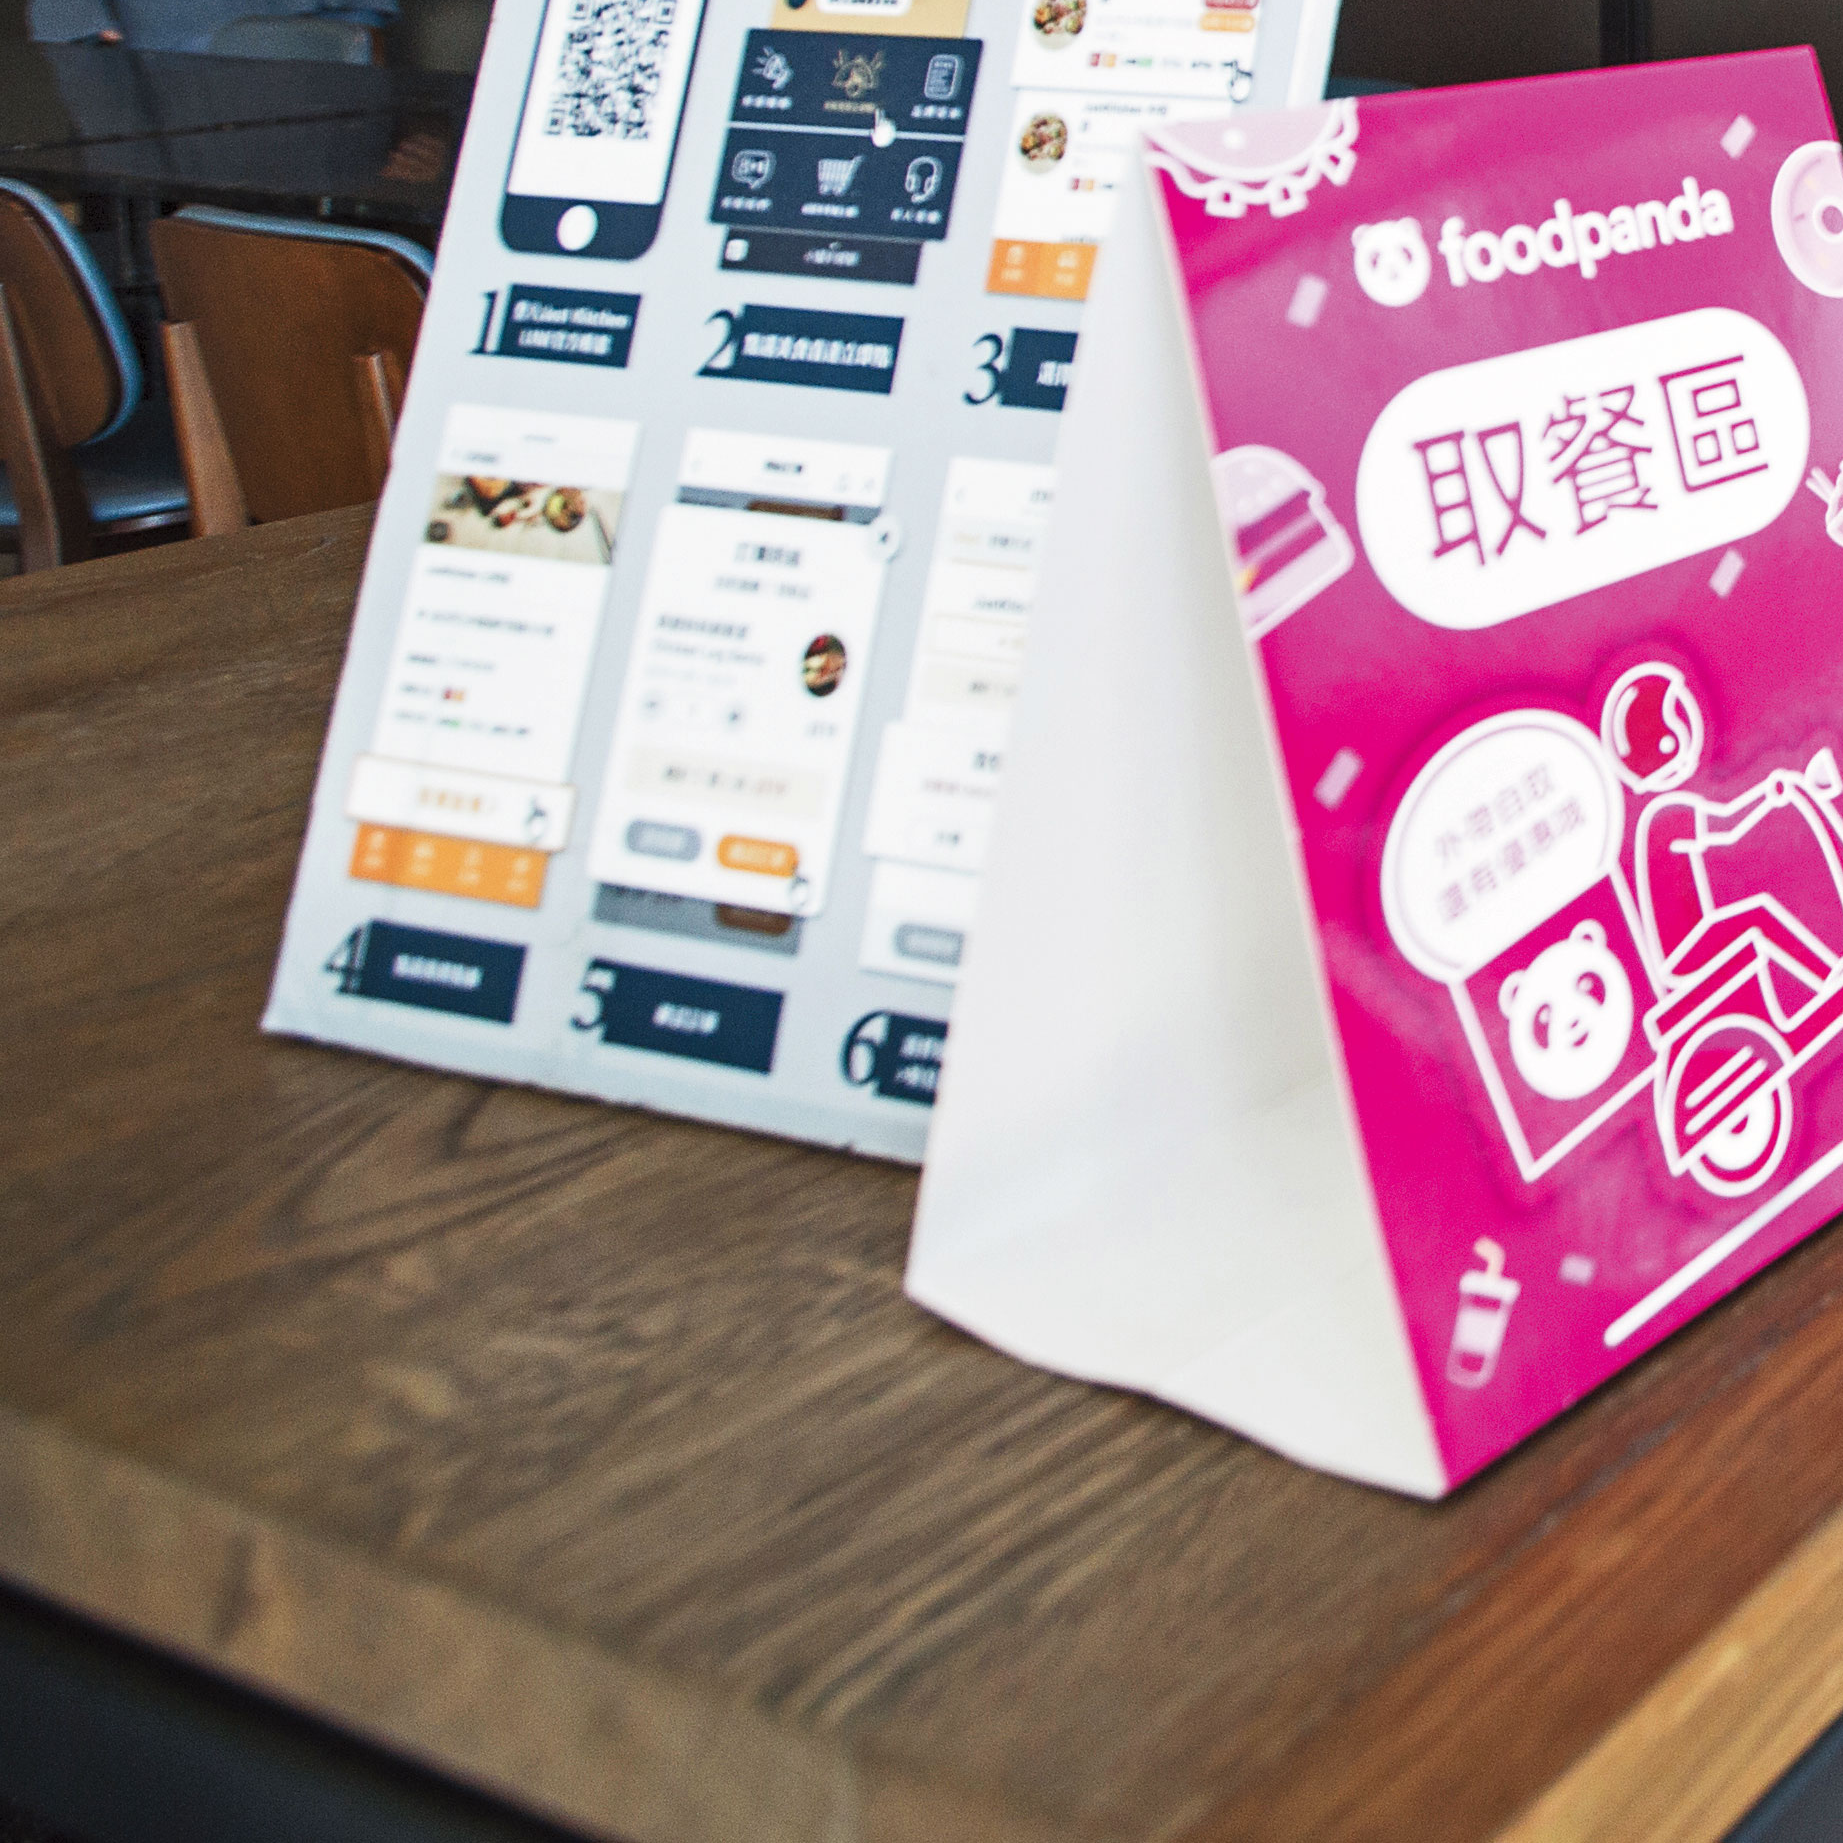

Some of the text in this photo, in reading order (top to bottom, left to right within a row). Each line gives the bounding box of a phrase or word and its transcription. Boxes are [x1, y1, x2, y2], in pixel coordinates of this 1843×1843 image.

[1437, 176, 1734, 287] foodpanda
[697, 309, 738, 376] 2
[962, 333, 1003, 405] 3
[1411, 354, 1770, 568] 取餐區
[839, 1009, 890, 1087] 6
